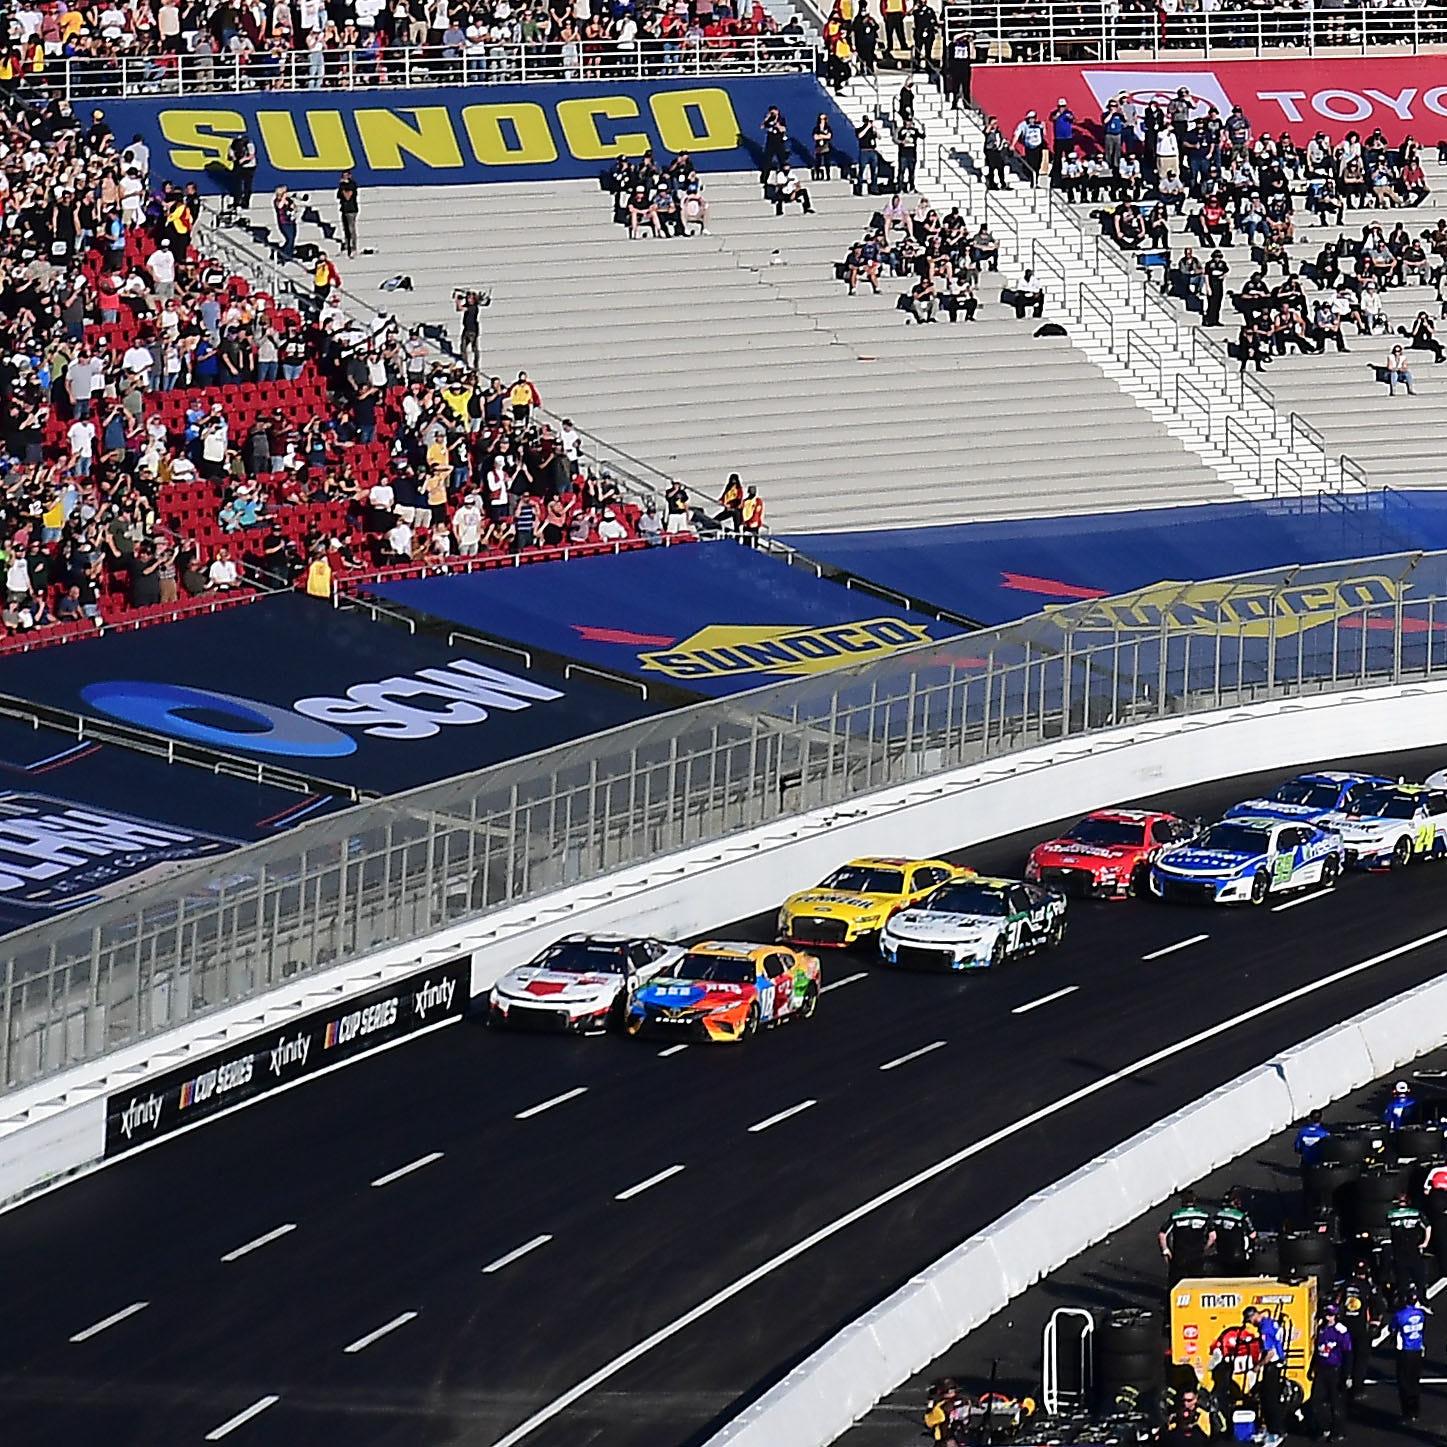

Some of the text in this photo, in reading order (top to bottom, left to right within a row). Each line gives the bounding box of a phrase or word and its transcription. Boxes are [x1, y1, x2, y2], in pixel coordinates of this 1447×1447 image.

[160, 87, 741, 171] SUNOCO
[1050, 577, 1397, 630] SUNOCO
[651, 621, 920, 674] SUNOCO
[1414, 823, 1436, 853] 24
[338, 997, 398, 1044] CUP SERIES
[414, 977, 456, 1019] xfinity
[269, 1031, 312, 1076] xfinity
[194, 1055, 254, 1103] CUP SERIES
[121, 1092, 164, 1139] xfinity
